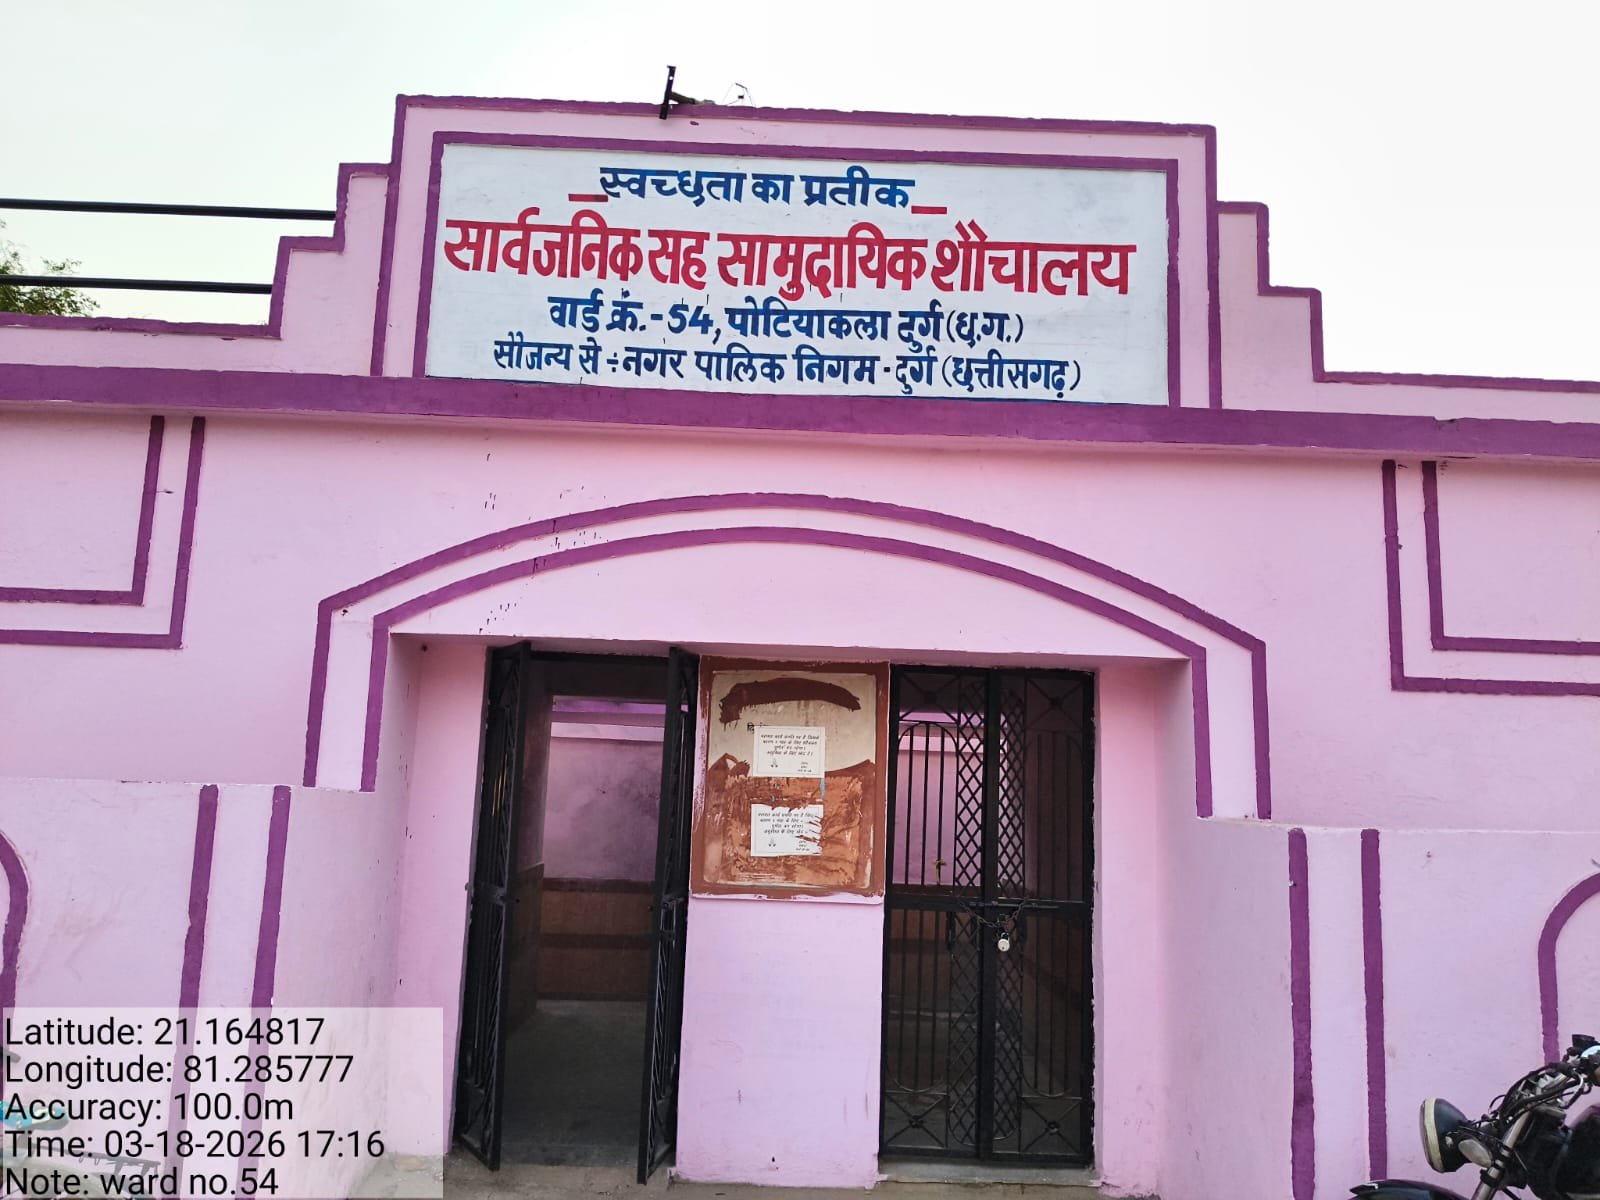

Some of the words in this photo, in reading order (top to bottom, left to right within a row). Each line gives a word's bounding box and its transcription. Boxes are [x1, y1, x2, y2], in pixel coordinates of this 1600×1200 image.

[600, 167, 747, 207] स्वच्छता
[752, 172, 795, 205] का
[800, 165, 915, 208] प्रतीक
[444, 207, 643, 282] सार्वजनिक
[648, 229, 711, 291] सह
[717, 221, 928, 301] सामुदायिक
[931, 219, 1137, 296] शौचालय
[547, 287, 605, 333] वार्ड
[494, 330, 575, 372] सौजन्य
[578, 336, 603, 375] से
[693, 342, 787, 384] पालिक
[791, 343, 880, 385] निगम
